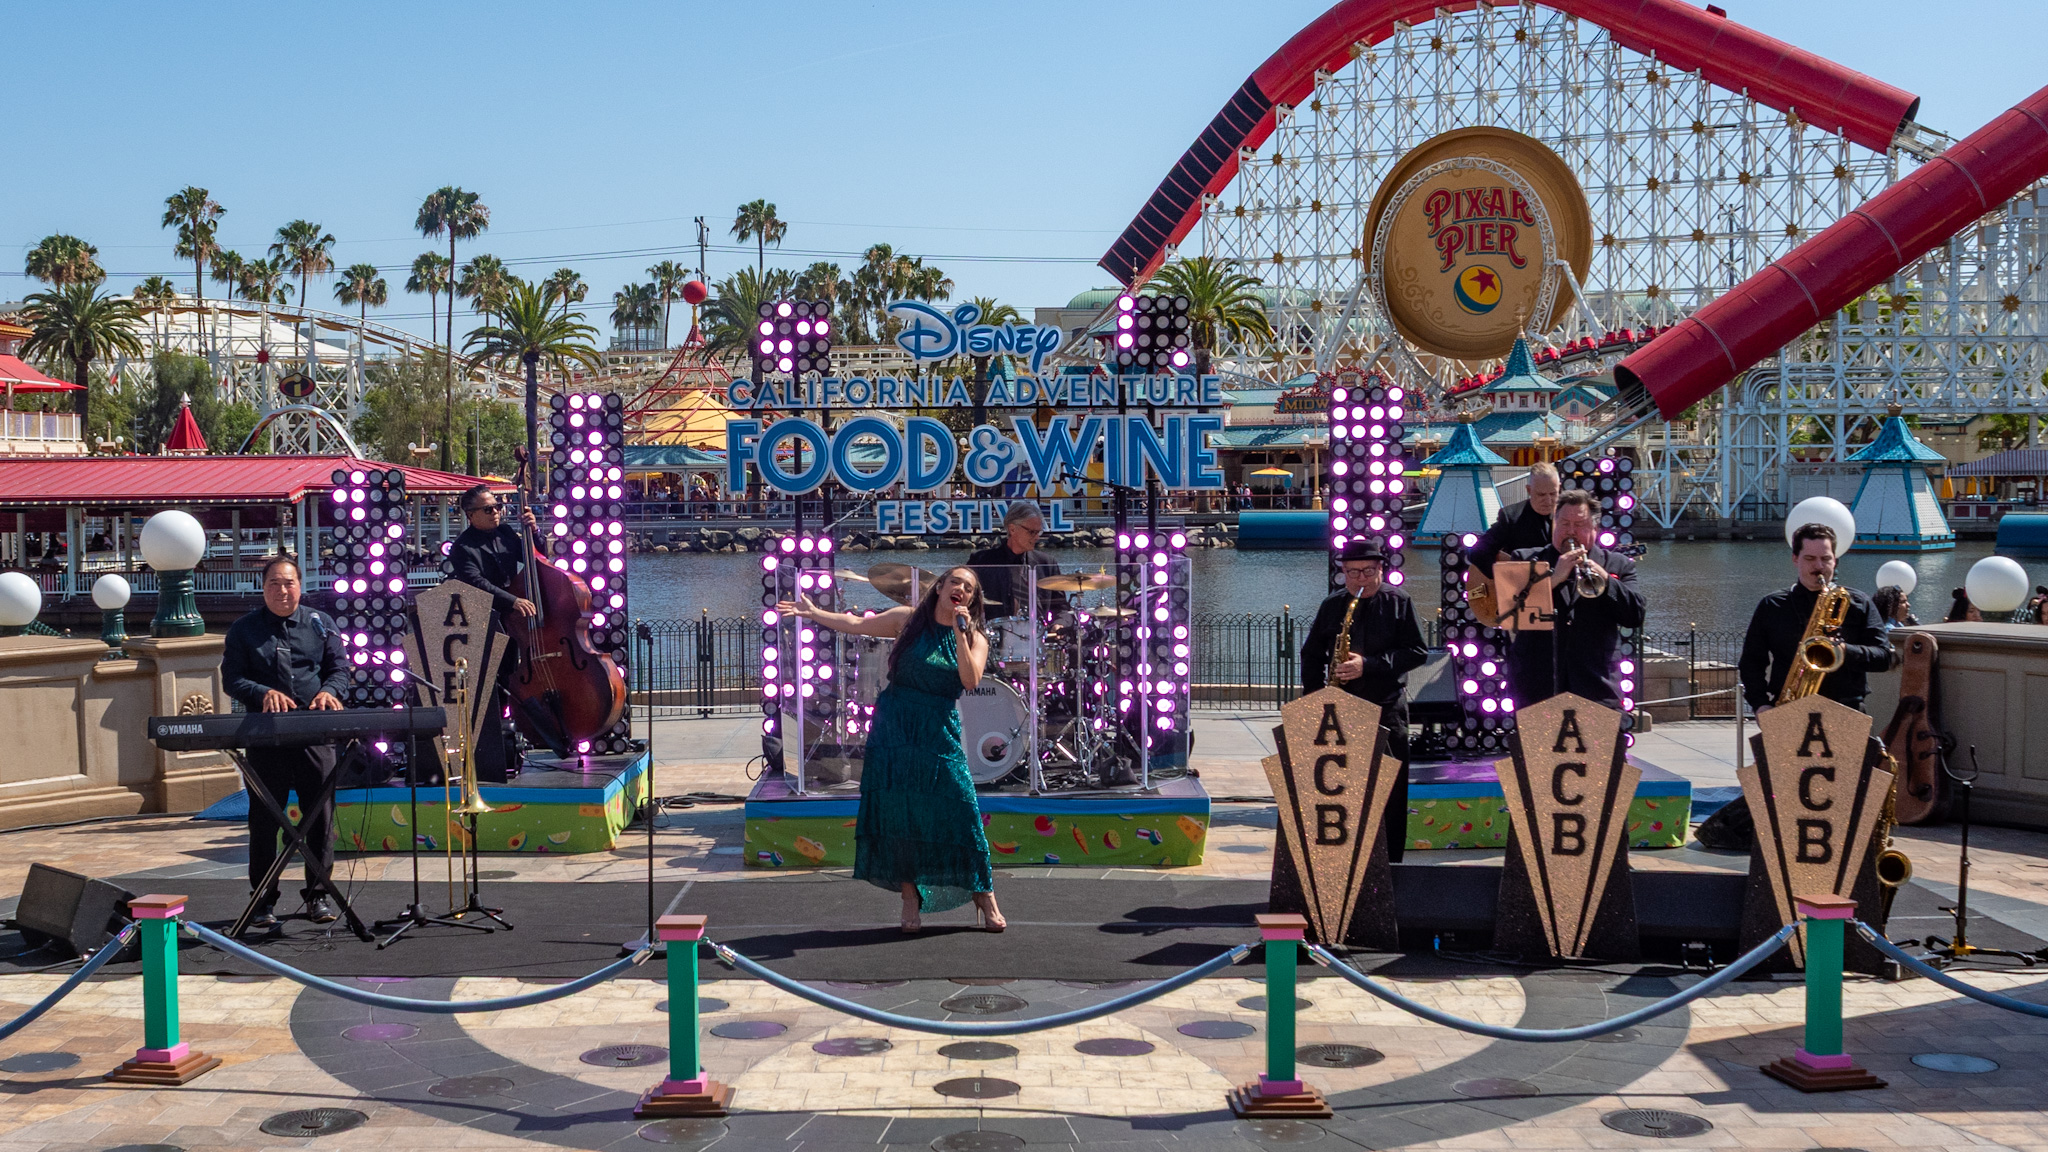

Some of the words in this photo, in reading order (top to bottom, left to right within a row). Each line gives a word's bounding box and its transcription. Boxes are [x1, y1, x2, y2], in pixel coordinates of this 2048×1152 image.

[1423, 187, 1536, 236] PIXAR
[1434, 221, 1527, 272] PIER
[727, 376, 973, 407] CALIFORNIA
[983, 374, 1223, 406] ADVENTURE
[727, 417, 957, 494] FOOD
[963, 424, 1016, 487] &
[1010, 416, 1225, 490] WINE
[877, 501, 1073, 533] FESTIL
[168, 724, 203, 734] YAMAHA
[1313, 703, 1348, 846] ACB
[1551, 709, 1587, 856] ACB
[1795, 712, 1836, 864] ACB
